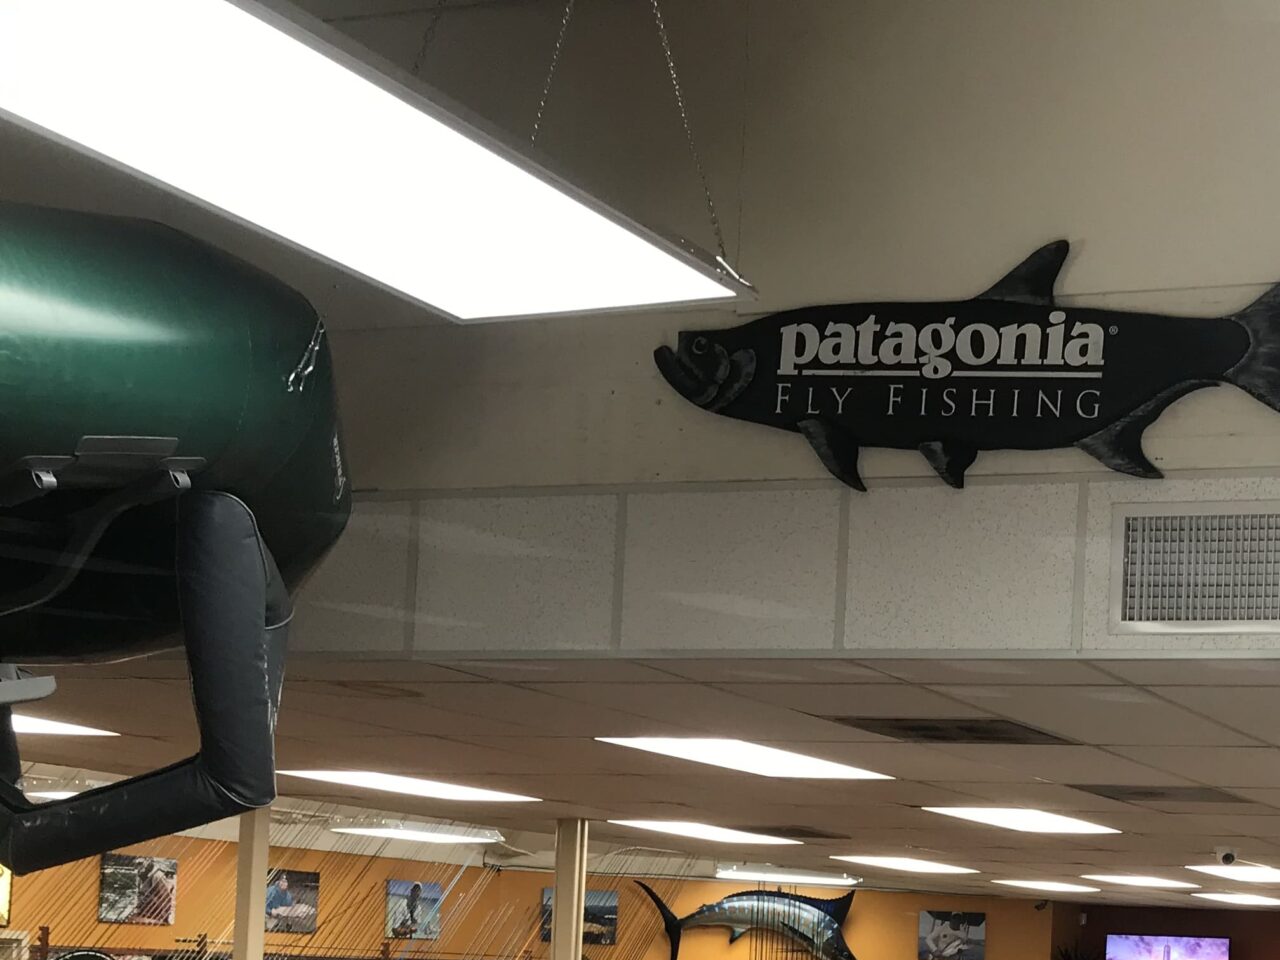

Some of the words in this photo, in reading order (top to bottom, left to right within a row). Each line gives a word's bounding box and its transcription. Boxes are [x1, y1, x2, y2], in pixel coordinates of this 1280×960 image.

[776, 310, 1105, 379] patagonia
[774, 383, 854, 415] FLY
[886, 384, 1101, 419] FISHING
